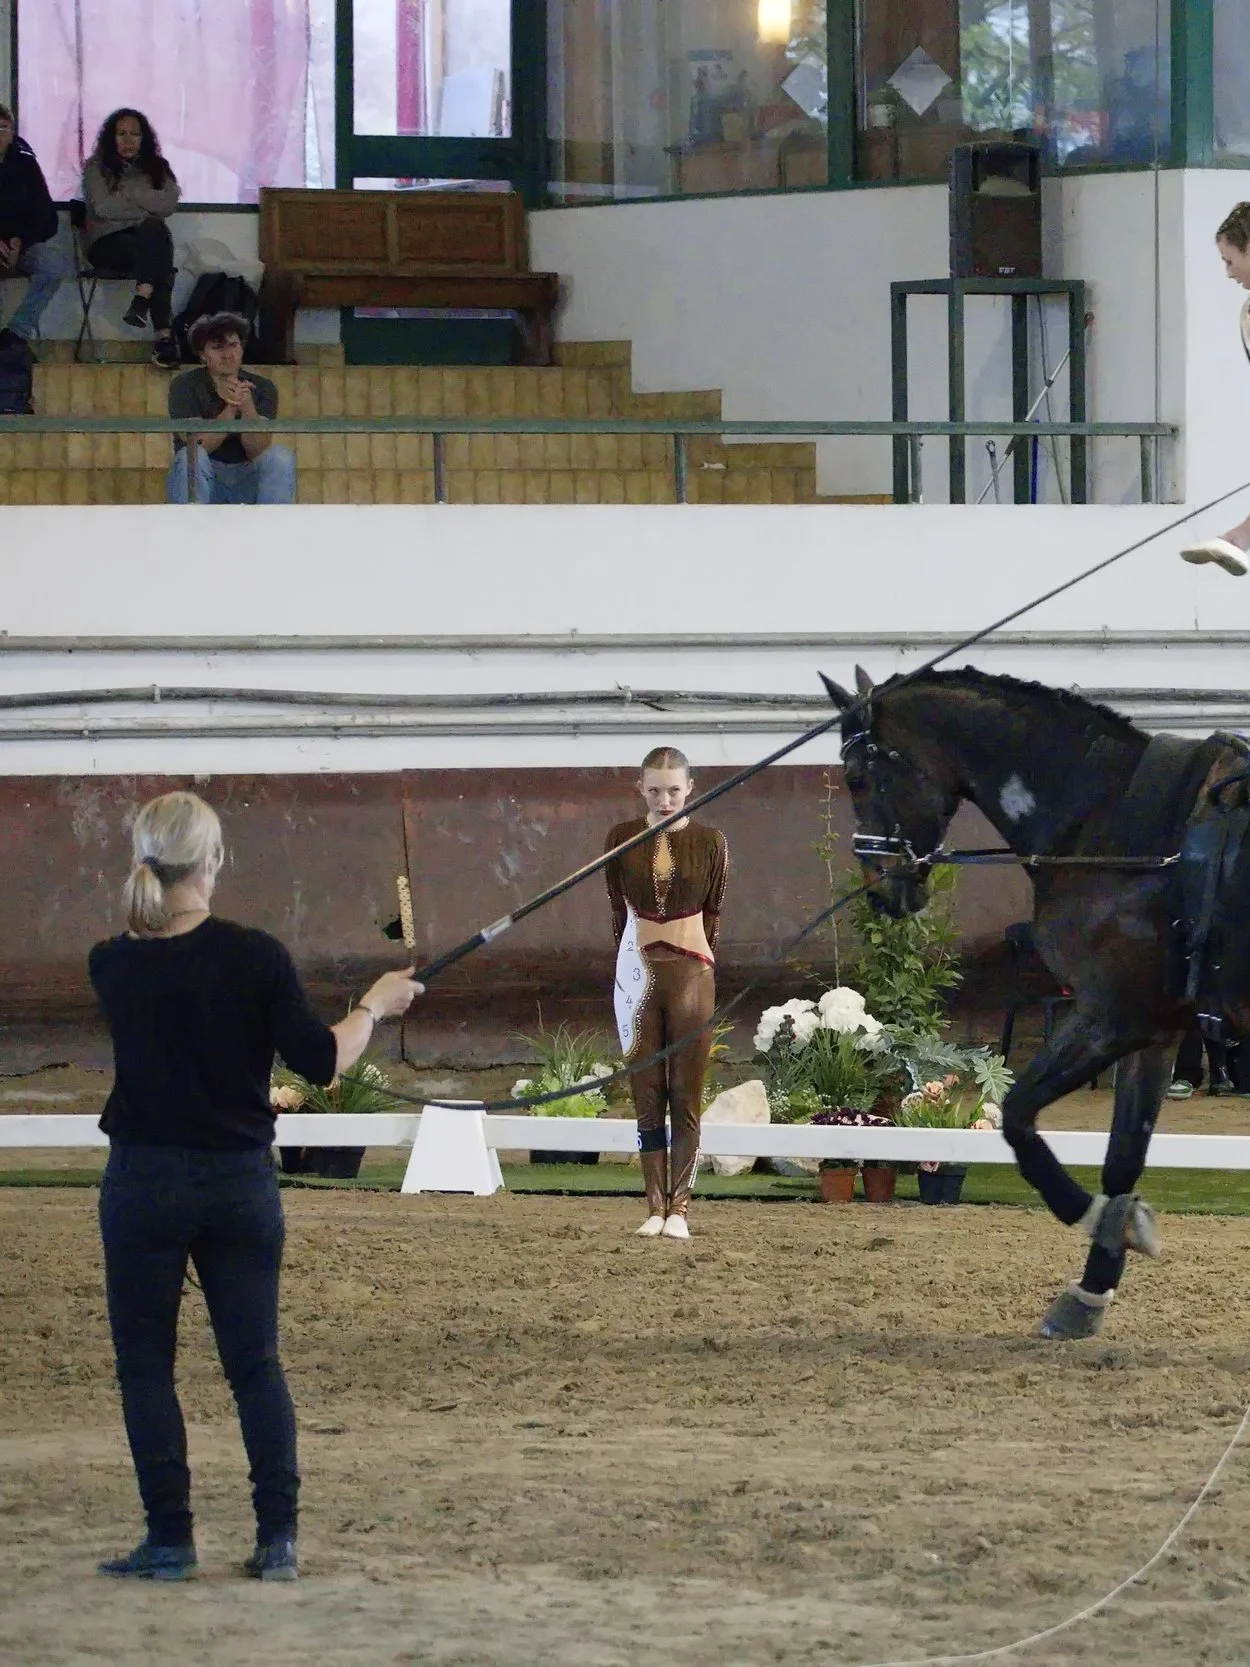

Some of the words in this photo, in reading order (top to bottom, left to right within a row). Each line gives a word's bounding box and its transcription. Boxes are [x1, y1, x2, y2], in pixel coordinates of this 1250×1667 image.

[626, 940, 634, 951] 2
[633, 967, 641, 981] 3
[622, 1023, 630, 1038] 5
